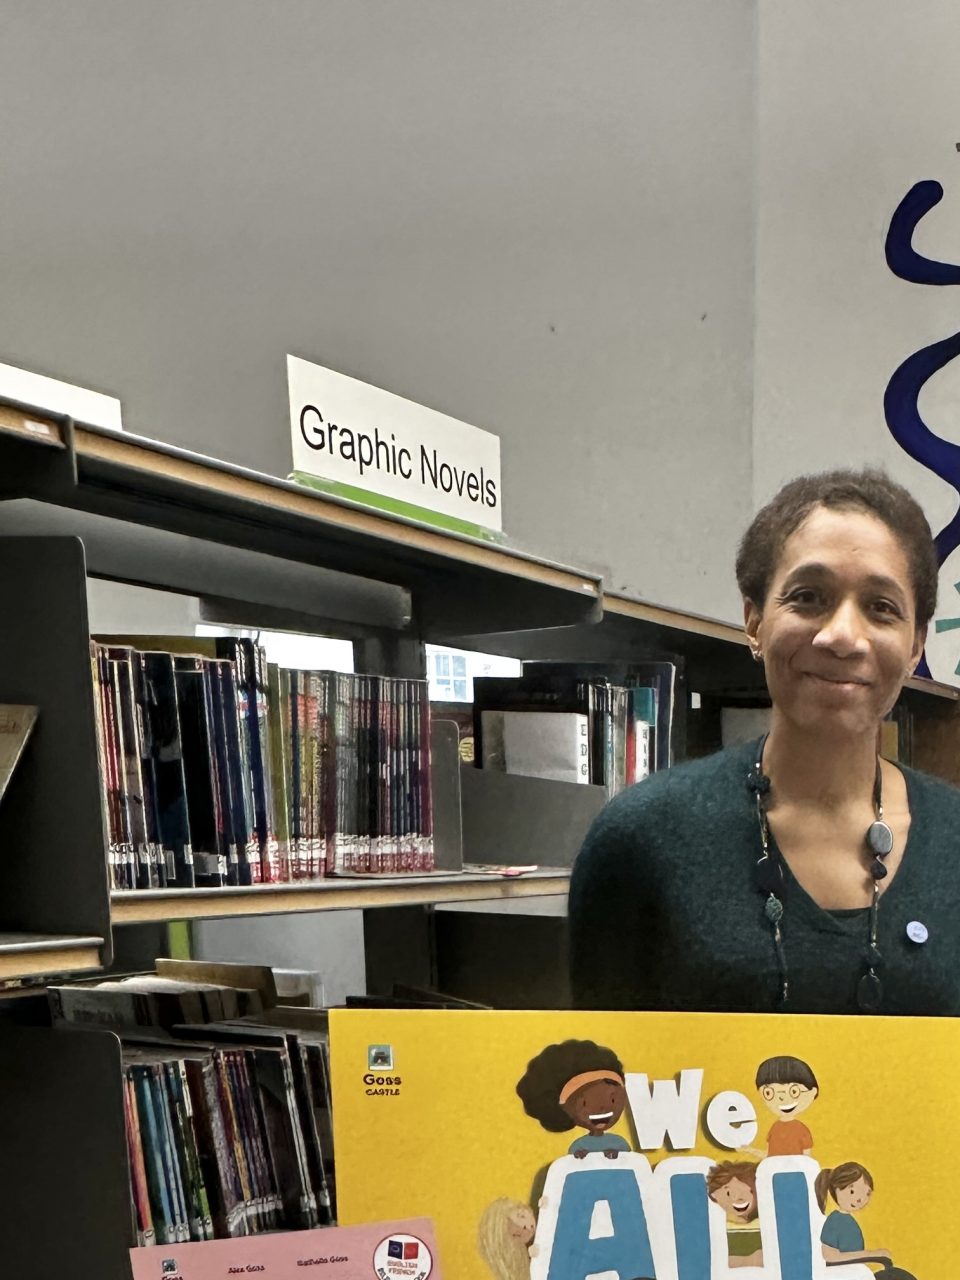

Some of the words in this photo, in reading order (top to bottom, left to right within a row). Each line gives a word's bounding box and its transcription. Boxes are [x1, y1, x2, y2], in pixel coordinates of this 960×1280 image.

[299, 404, 412, 480] Graphic
[420, 444, 497, 508] Novels
[624, 1067, 758, 1150] We
